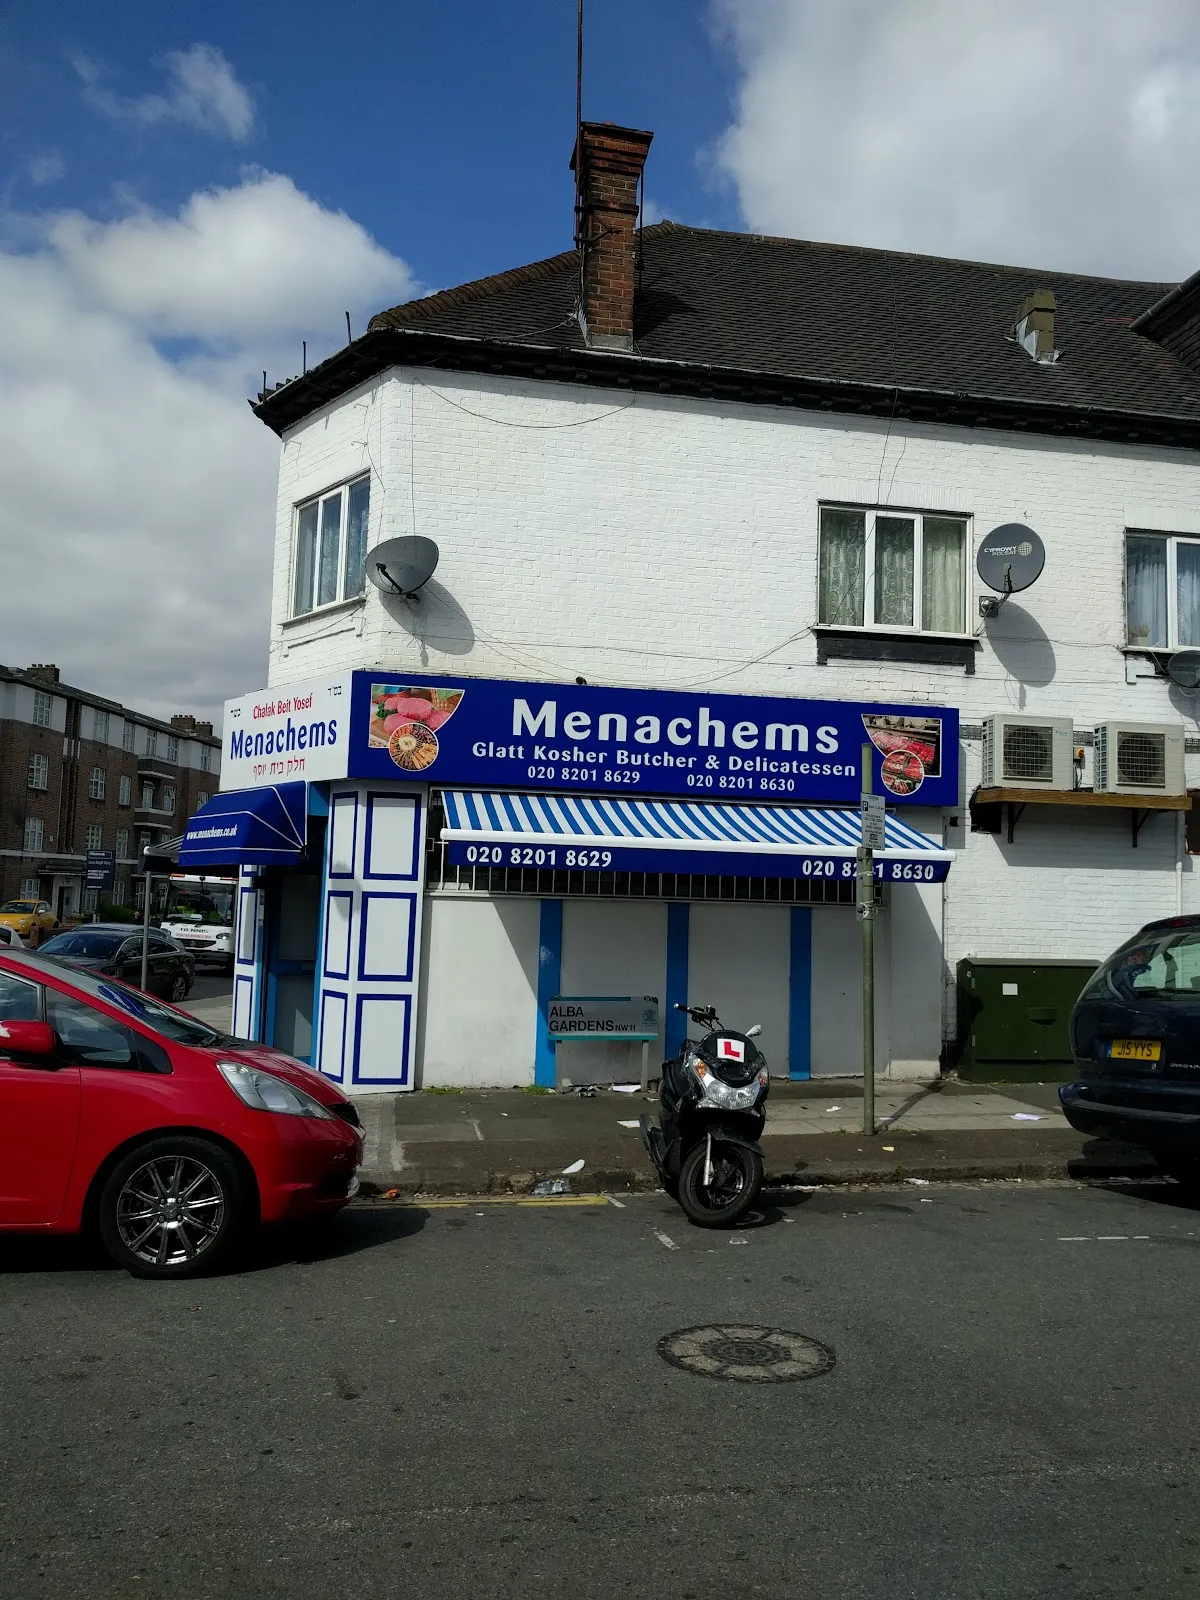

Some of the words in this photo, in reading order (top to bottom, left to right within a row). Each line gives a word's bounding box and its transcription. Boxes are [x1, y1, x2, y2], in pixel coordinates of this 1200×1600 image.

[253, 702, 276, 720] Chalak
[278, 699, 291, 714] Beit
[294, 692, 313, 711] Yosef
[512, 698, 839, 754] Menachems
[230, 718, 337, 760] Menachems
[472, 741, 524, 760] Glatt
[534, 745, 608, 764] Kosher
[616, 750, 697, 768] Butcher
[704, 754, 720, 770] &
[728, 756, 856, 777] Delicatessen
[527, 766, 555, 780] 020
[561, 767, 598, 782] 8201
[604, 770, 641, 784] 8629
[686, 774, 714, 788] 020
[719, 776, 753, 790] 8201
[760, 778, 795, 792] 8630
[186, 824, 238, 840] www.menachems.co.uk
[466, 845, 502, 864] 020
[510, 847, 556, 866] 8201
[565, 850, 612, 868] 8629
[802, 860, 835, 876] 020
[841, 861, 884, 878] 81
[892, 863, 934, 880] 8630
[550, 1006, 584, 1018] ALBA
[549, 1019, 614, 1032] GARDENS
[615, 1024, 636, 1032] NW11
[724, 1041, 741, 1058] L
